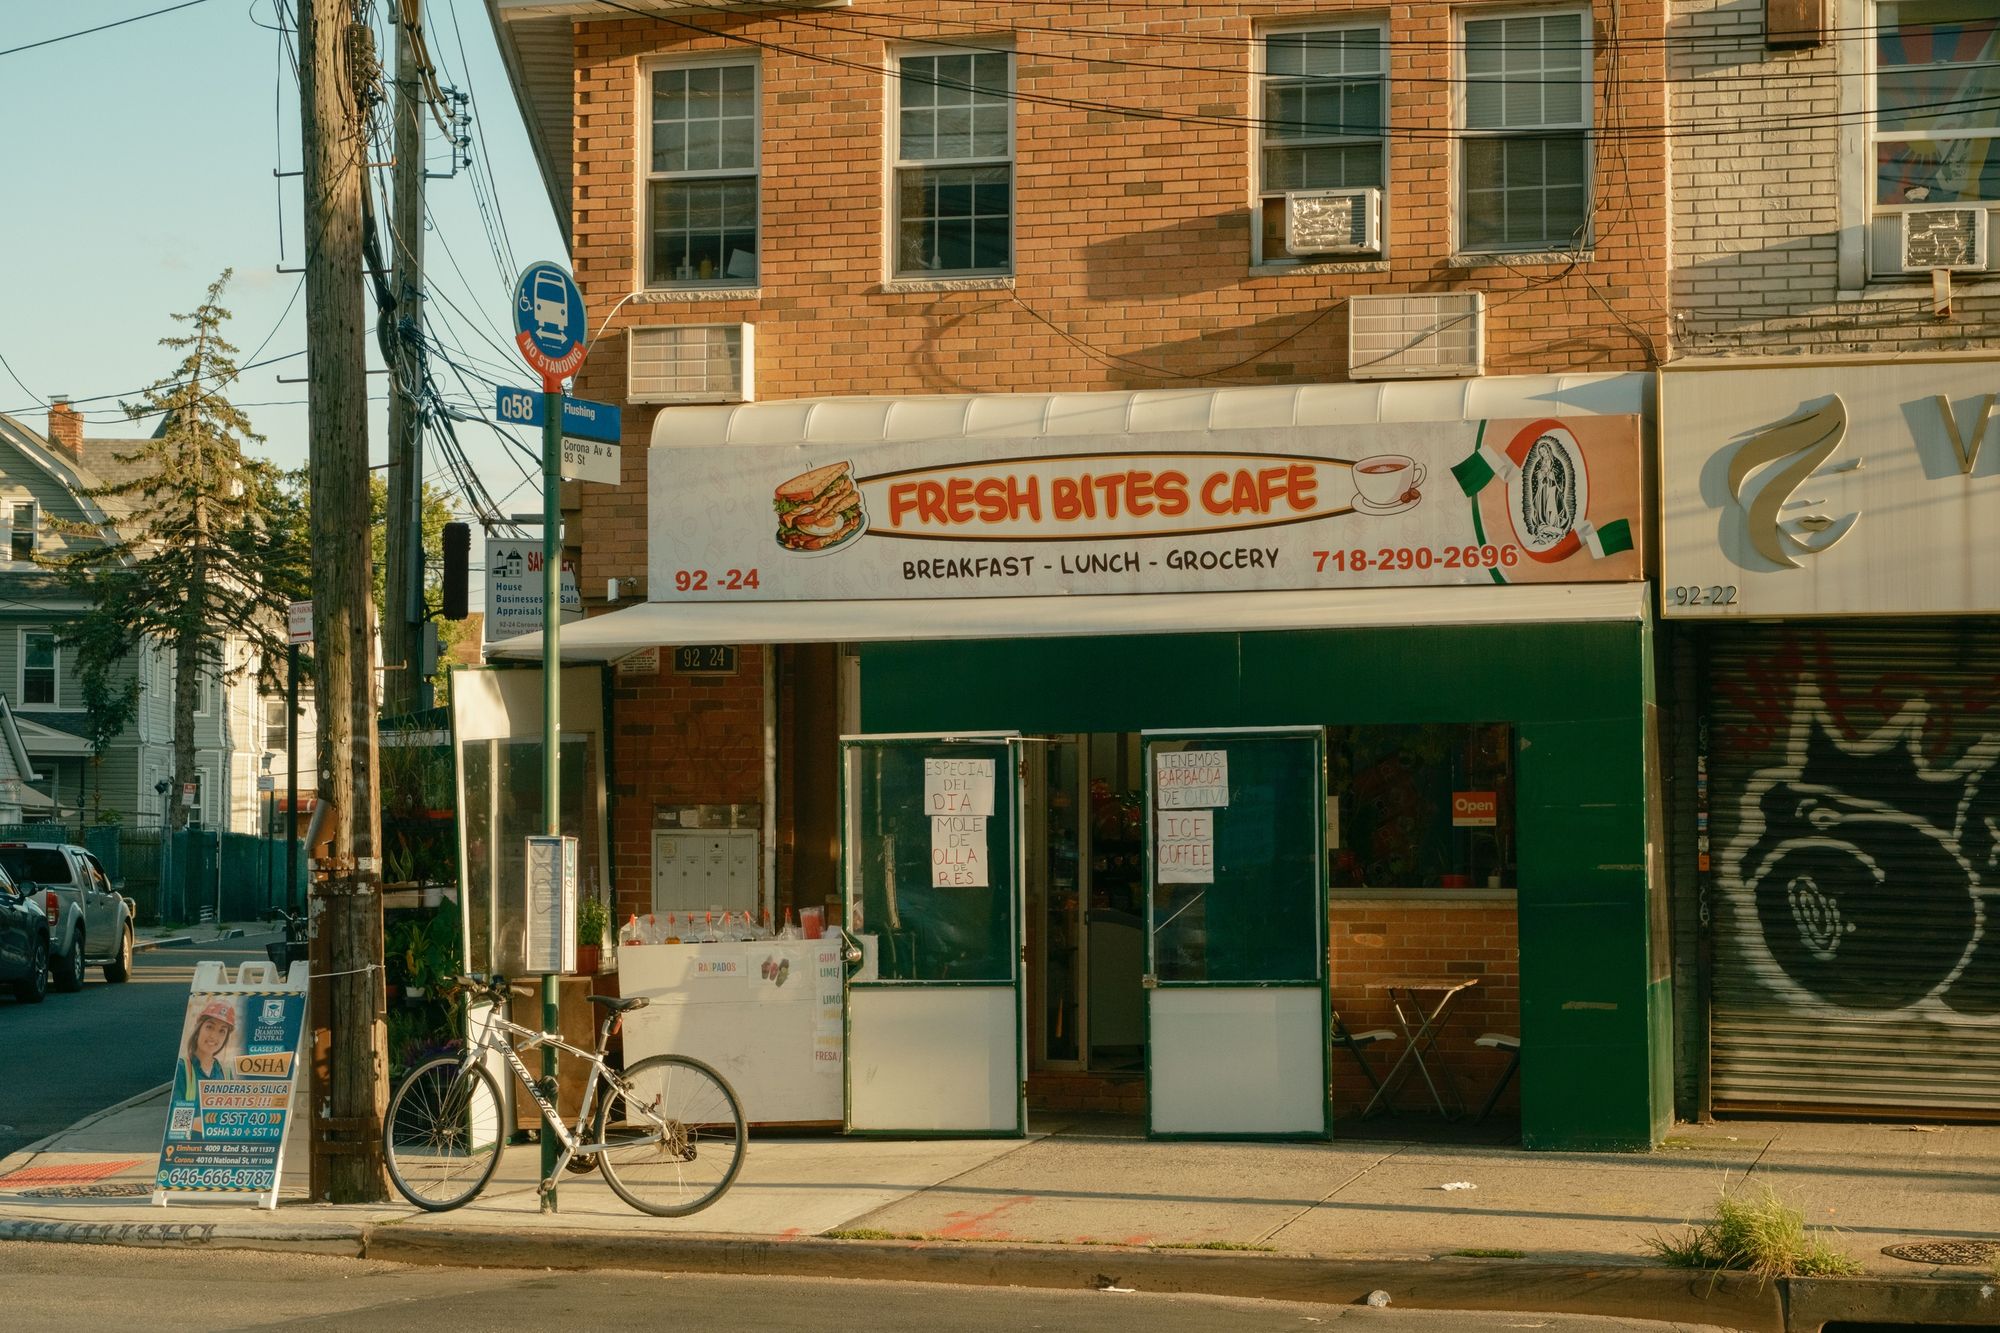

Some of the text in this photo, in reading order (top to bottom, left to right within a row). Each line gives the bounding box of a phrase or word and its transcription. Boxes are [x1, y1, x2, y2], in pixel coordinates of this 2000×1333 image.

[524, 337, 582, 374] NO STANDING
[501, 394, 533, 420] Q58
[563, 403, 595, 421] Flushing
[563, 439, 613, 457] Corona Av &
[563, 452, 586, 465] 93 St
[888, 463, 1318, 526] FRESH BITES CAFE
[902, 555, 1035, 580] BREAKFAST
[1059, 551, 1141, 575] LUNCH
[1165, 547, 1280, 571] GROCERY
[1312, 544, 1518, 573] 718-290-2696
[497, 582, 522, 592] House
[496, 594, 543, 603] Businesses
[1675, 585, 1738, 606] 92-22
[497, 607, 543, 616] Appraisals
[684, 647, 725, 668] 92 24
[1160, 752, 1221, 768] TENEMOS
[925, 761, 993, 778] ESPECIAL
[1158, 768, 1221, 787] BARBACOA
[943, 779, 972, 792] DEL
[932, 793, 973, 812] DIA
[1161, 790, 1180, 807] DE
[1455, 798, 1494, 814] Open
[937, 817, 983, 833] MOLE
[1167, 818, 1206, 838] ICE
[949, 833, 970, 849] DE
[932, 848, 978, 866] OLLA
[1159, 844, 1211, 866] COFFEE
[952, 864, 968, 872] DE
[938, 871, 975, 886] RES
[255, 1028, 285, 1036] DIAMOND
[815, 1051, 837, 1061] FRESA
[240, 1058, 286, 1073] OSHA
[203, 1084, 251, 1095] BANDERAS
[259, 1084, 288, 1095] SILICA
[204, 1096, 255, 1107] GRATIS
[220, 1112, 268, 1126] SST 40
[206, 1127, 230, 1137] OSHA
[231, 1127, 243, 1137] 30
[252, 1127, 268, 1137] SST
[269, 1127, 281, 1137] 10
[204, 1144, 221, 1152] 4009
[222, 1144, 239, 1152] 82nd
[196, 1156, 213, 1164] 4010
[213, 1156, 241, 1164] National
[169, 1169, 274, 1186] 646-666-8787
